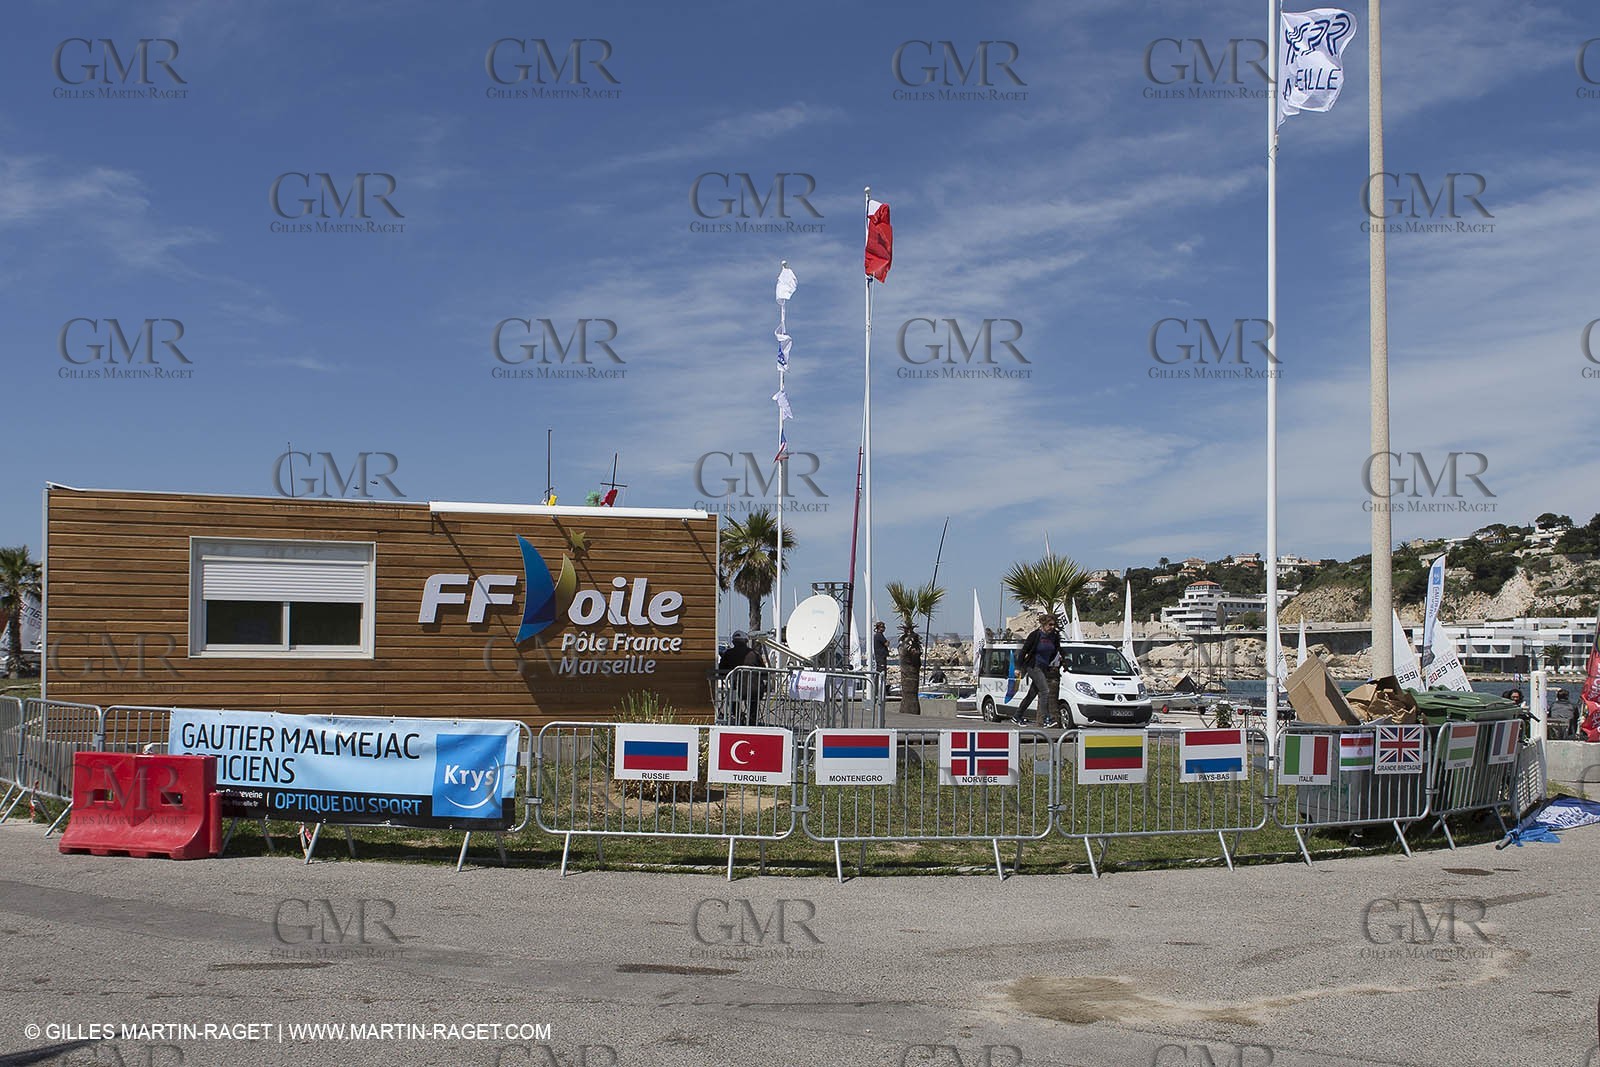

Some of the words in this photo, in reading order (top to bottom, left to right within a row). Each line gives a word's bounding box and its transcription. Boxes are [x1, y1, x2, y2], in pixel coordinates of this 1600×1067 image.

[561, 631, 608, 652] Pôle
[612, 633, 682, 652] France
[558, 655, 656, 675] Marseille
[182, 722, 274, 754] GAUTIER
[281, 727, 420, 760] MALMEJAC
[183, 753, 295, 784] TICIENS
[444, 763, 495, 793] Krys
[641, 772, 670, 780] RUSSIE
[733, 774, 767, 782] TURQUIE
[1198, 773, 1230, 781] PAYS-BAS
[829, 775, 883, 783] MONTENEGRO
[275, 792, 340, 814] OPTIQUE
[344, 795, 364, 813] DU
[368, 796, 422, 816] SPORT
